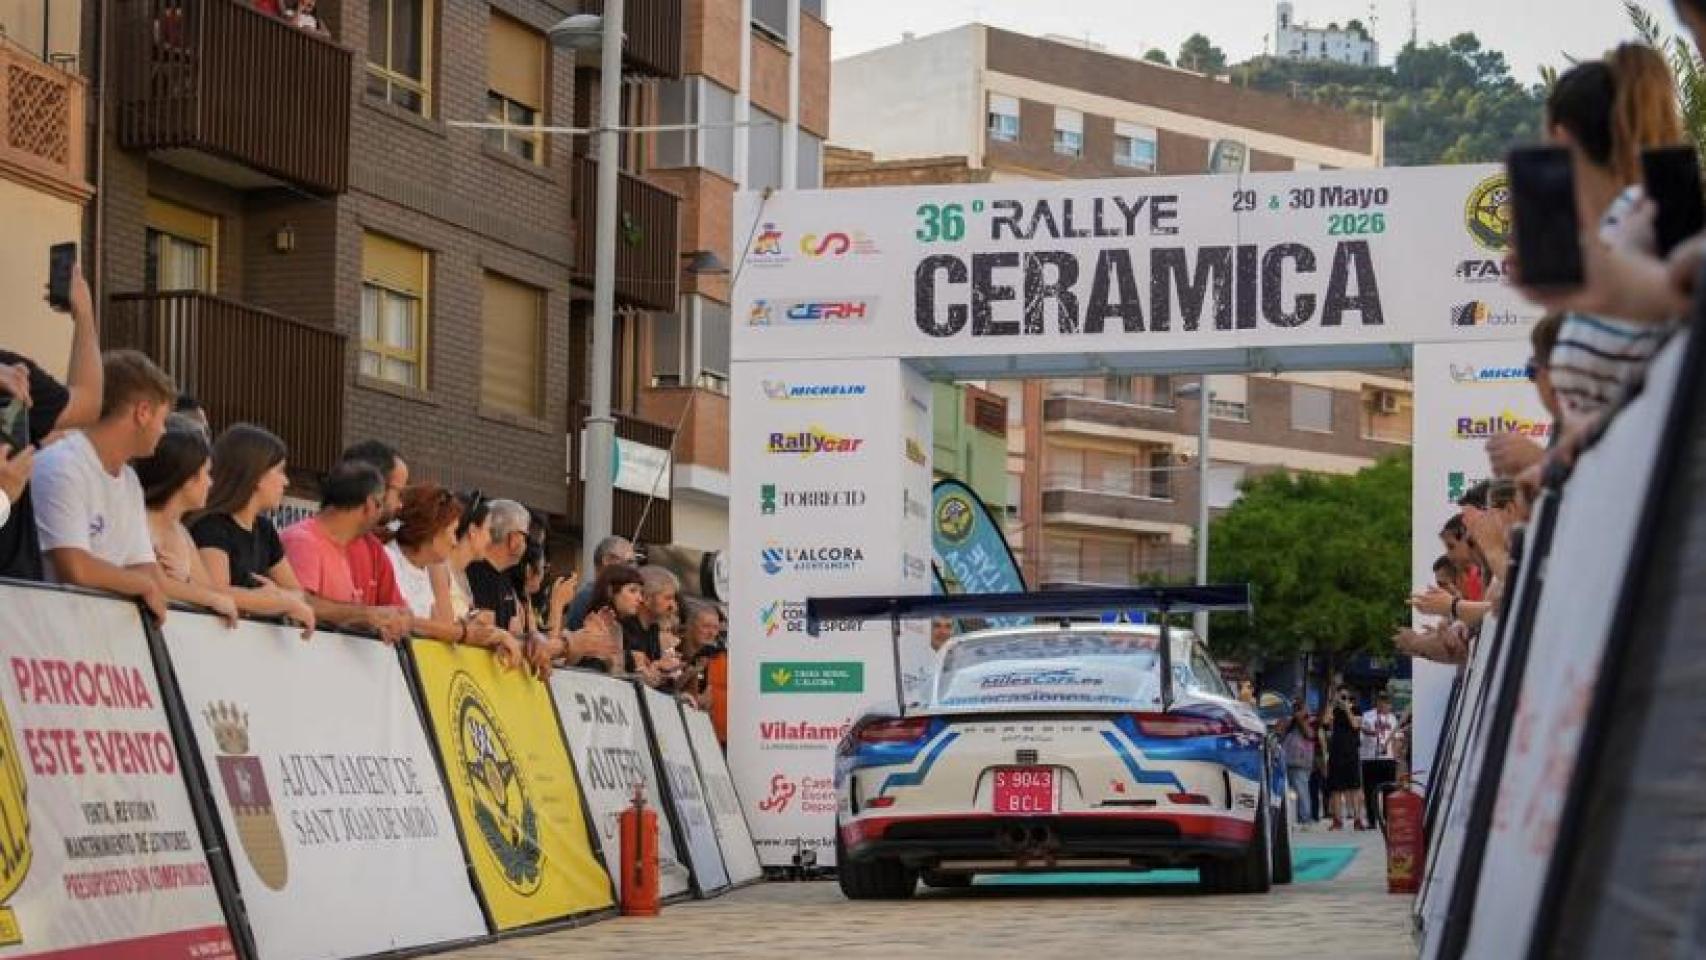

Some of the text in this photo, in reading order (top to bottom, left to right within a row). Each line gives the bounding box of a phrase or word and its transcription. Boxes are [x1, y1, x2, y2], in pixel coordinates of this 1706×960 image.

[1232, 184, 1389, 212] 29 & 30 Mayo
[991, 194, 1179, 240] RALLYE
[1328, 213, 1386, 236] 2026
[914, 239, 1385, 338] CERAMICA
[787, 302, 866, 319] CERH
[790, 384, 866, 396] MICHELIN
[786, 547, 864, 562] L'ALCORA
[10, 657, 153, 709] PATROCINA
[23, 728, 177, 776] ESTE EVENTO
[1012, 771, 1051, 787] 9043
[1009, 796, 1043, 812] BCL
